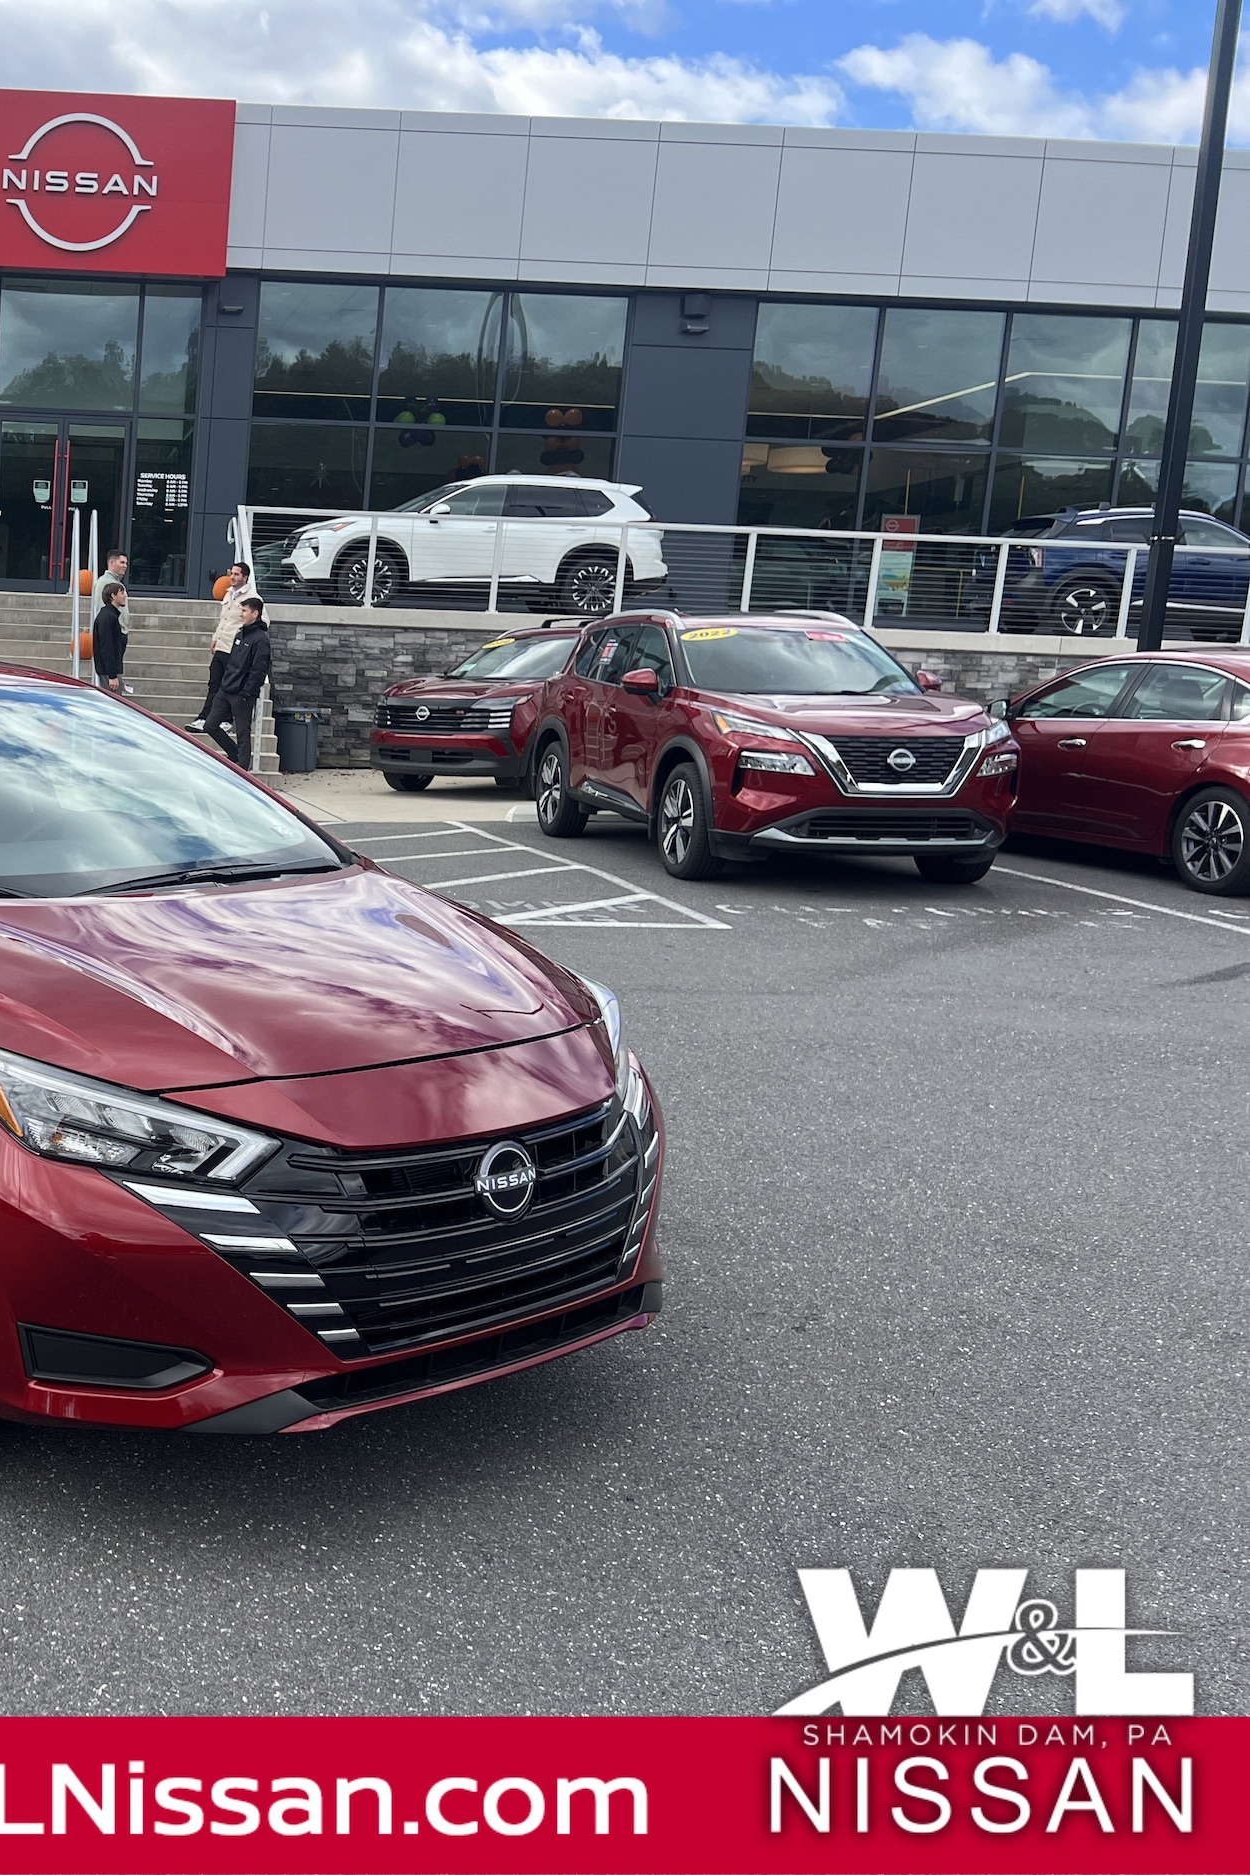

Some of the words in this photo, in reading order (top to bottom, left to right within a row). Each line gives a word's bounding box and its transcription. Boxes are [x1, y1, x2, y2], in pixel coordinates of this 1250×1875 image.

[2, 168, 158, 197] NISSAN
[689, 629, 731, 639] 2022
[476, 1168, 537, 1192] NISSAN
